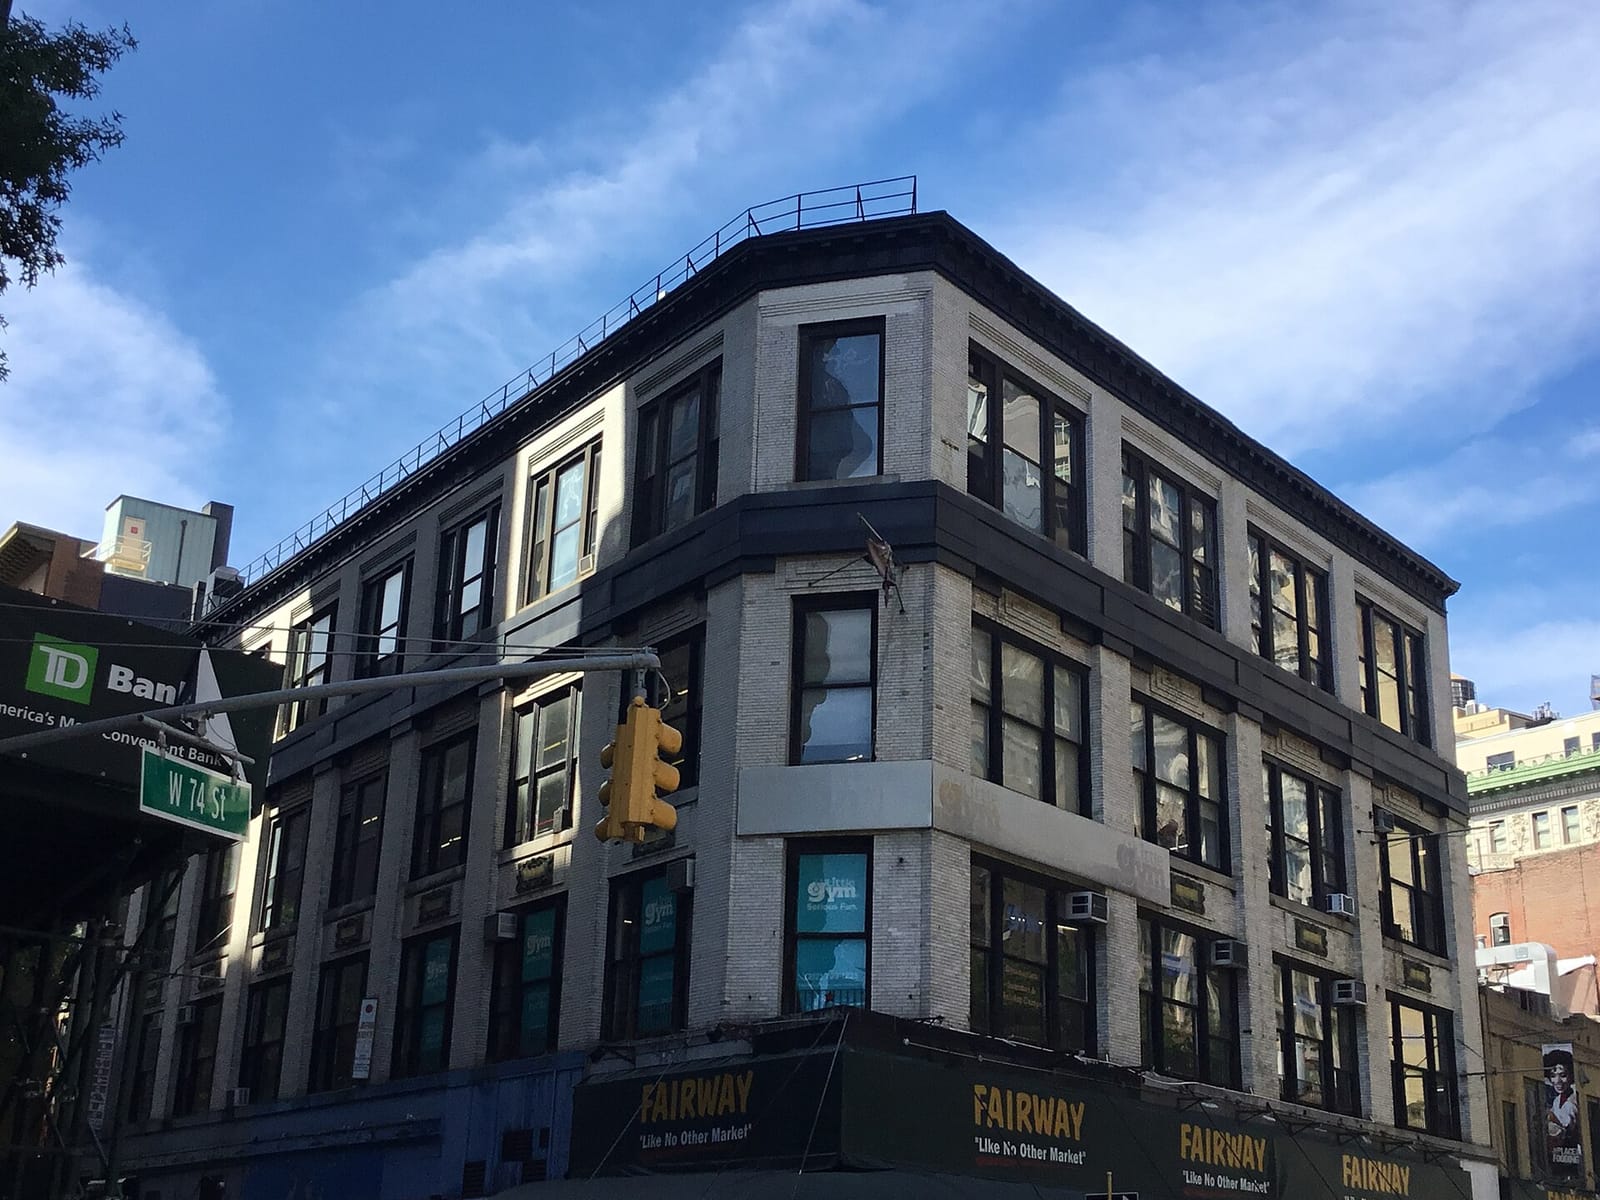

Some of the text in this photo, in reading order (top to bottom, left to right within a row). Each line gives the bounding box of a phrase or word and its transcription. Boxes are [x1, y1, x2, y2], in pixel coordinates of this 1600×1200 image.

[40, 645, 88, 689] TD
[0, 703, 55, 726] merica's
[169, 770, 226, 821] W 74 St
[807, 882, 857, 903] gym
[644, 903, 674, 927] gym
[641, 1070, 754, 1123] FAIRWAY
[974, 1084, 1086, 1141] FAIRWAY
[664, 1132, 678, 1147] No
[680, 1129, 709, 1147] Other
[1020, 1143, 1048, 1160] Other
[1180, 1123, 1266, 1173] FAIRWAY
[1204, 1173, 1215, 1187] No
[1217, 1175, 1239, 1190] Other
[1342, 1154, 1410, 1197] FAIRWAY
